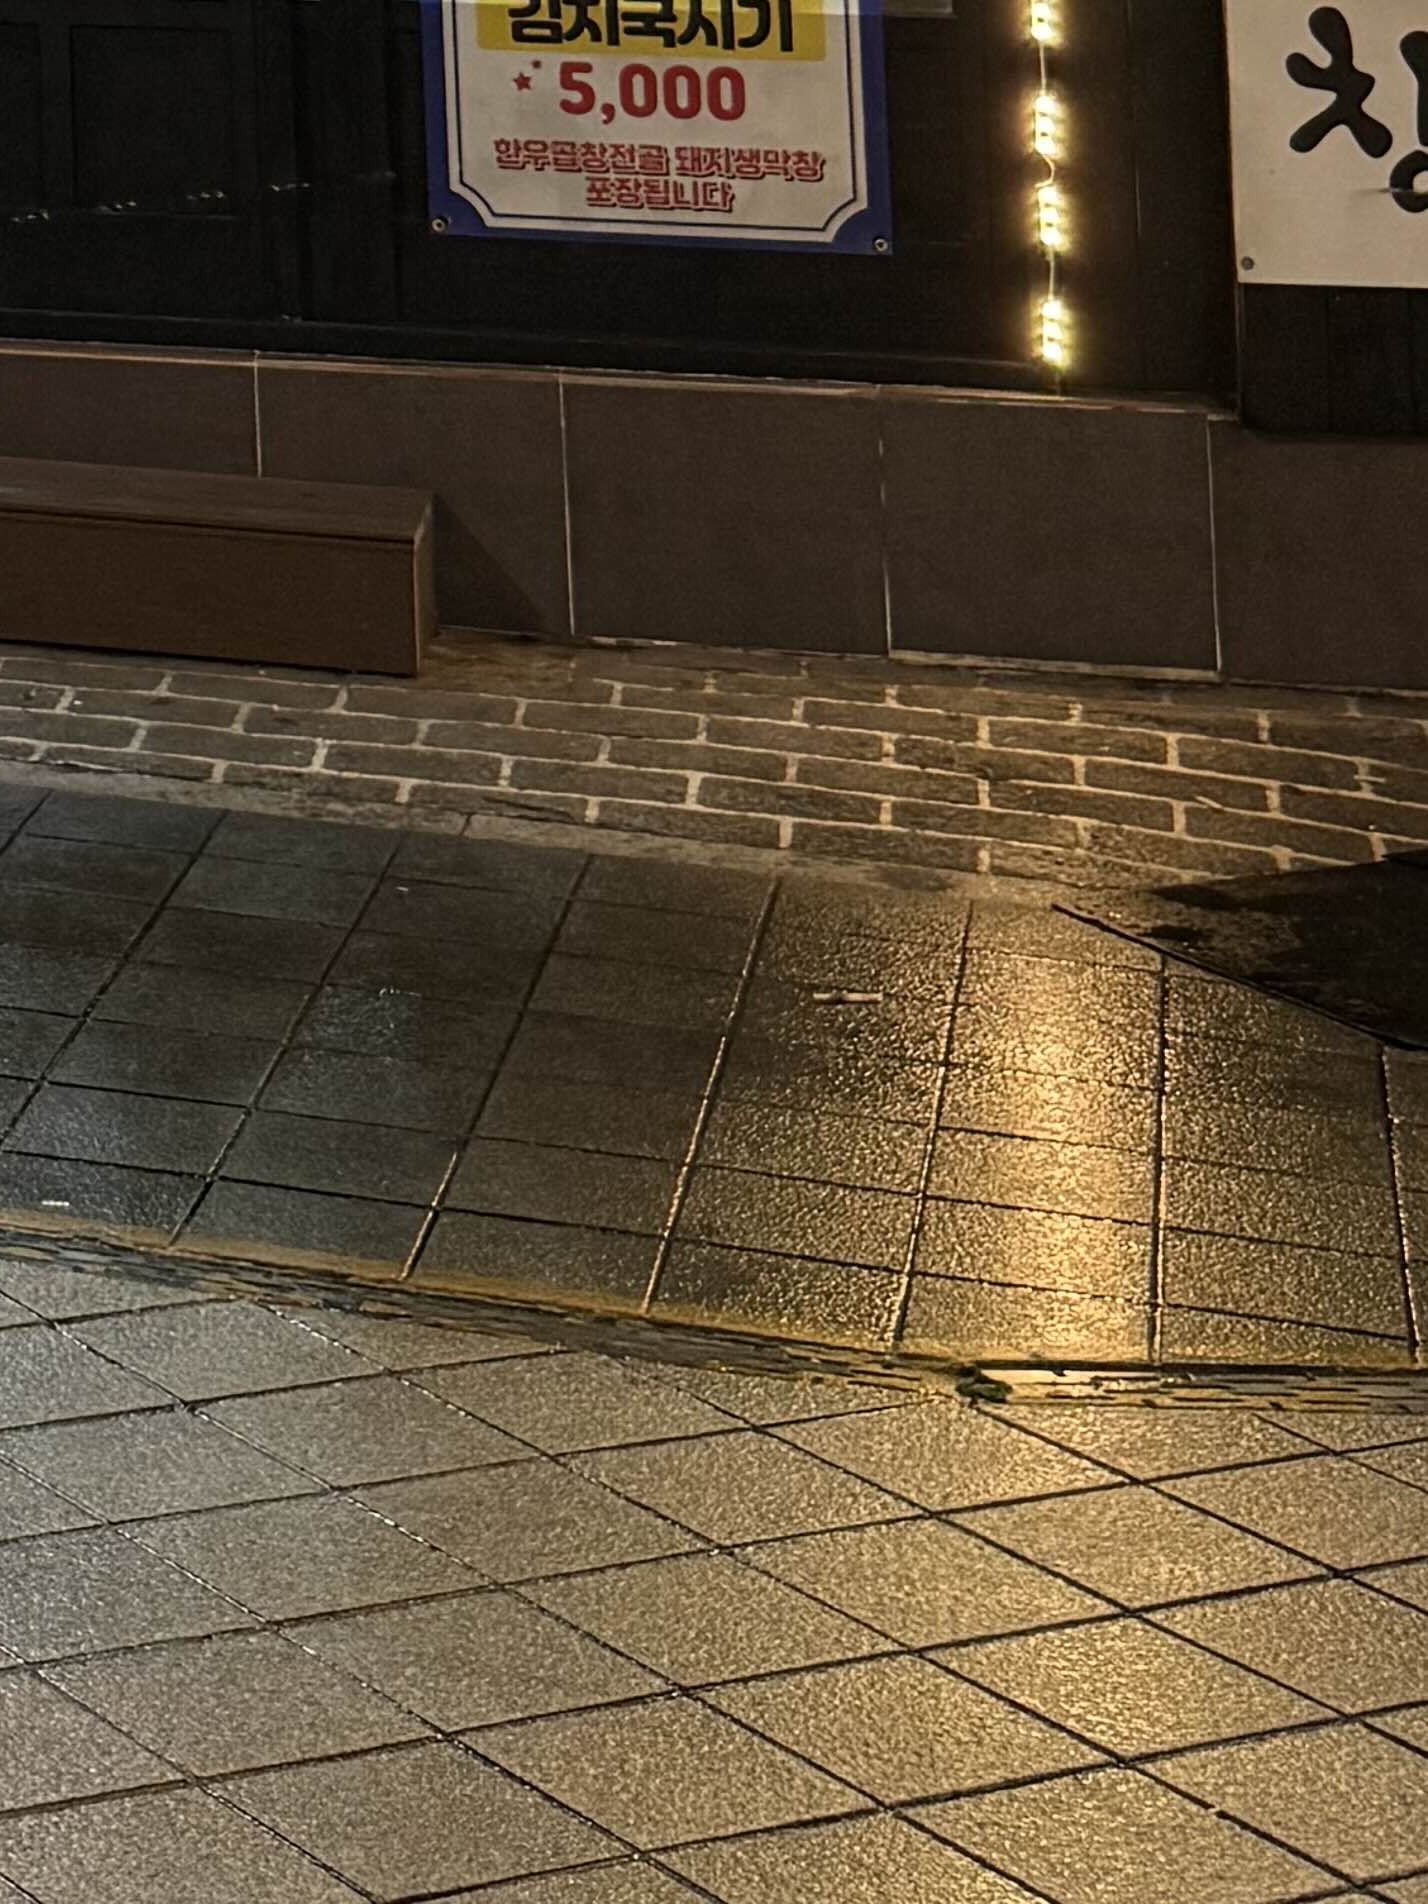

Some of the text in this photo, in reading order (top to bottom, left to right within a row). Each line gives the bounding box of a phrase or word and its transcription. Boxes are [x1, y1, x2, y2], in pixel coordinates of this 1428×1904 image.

[559, 61, 746, 124] 5,000
[493, 138, 670, 176] 한우곱창전골
[584, 175, 736, 214] 포장됩니다
